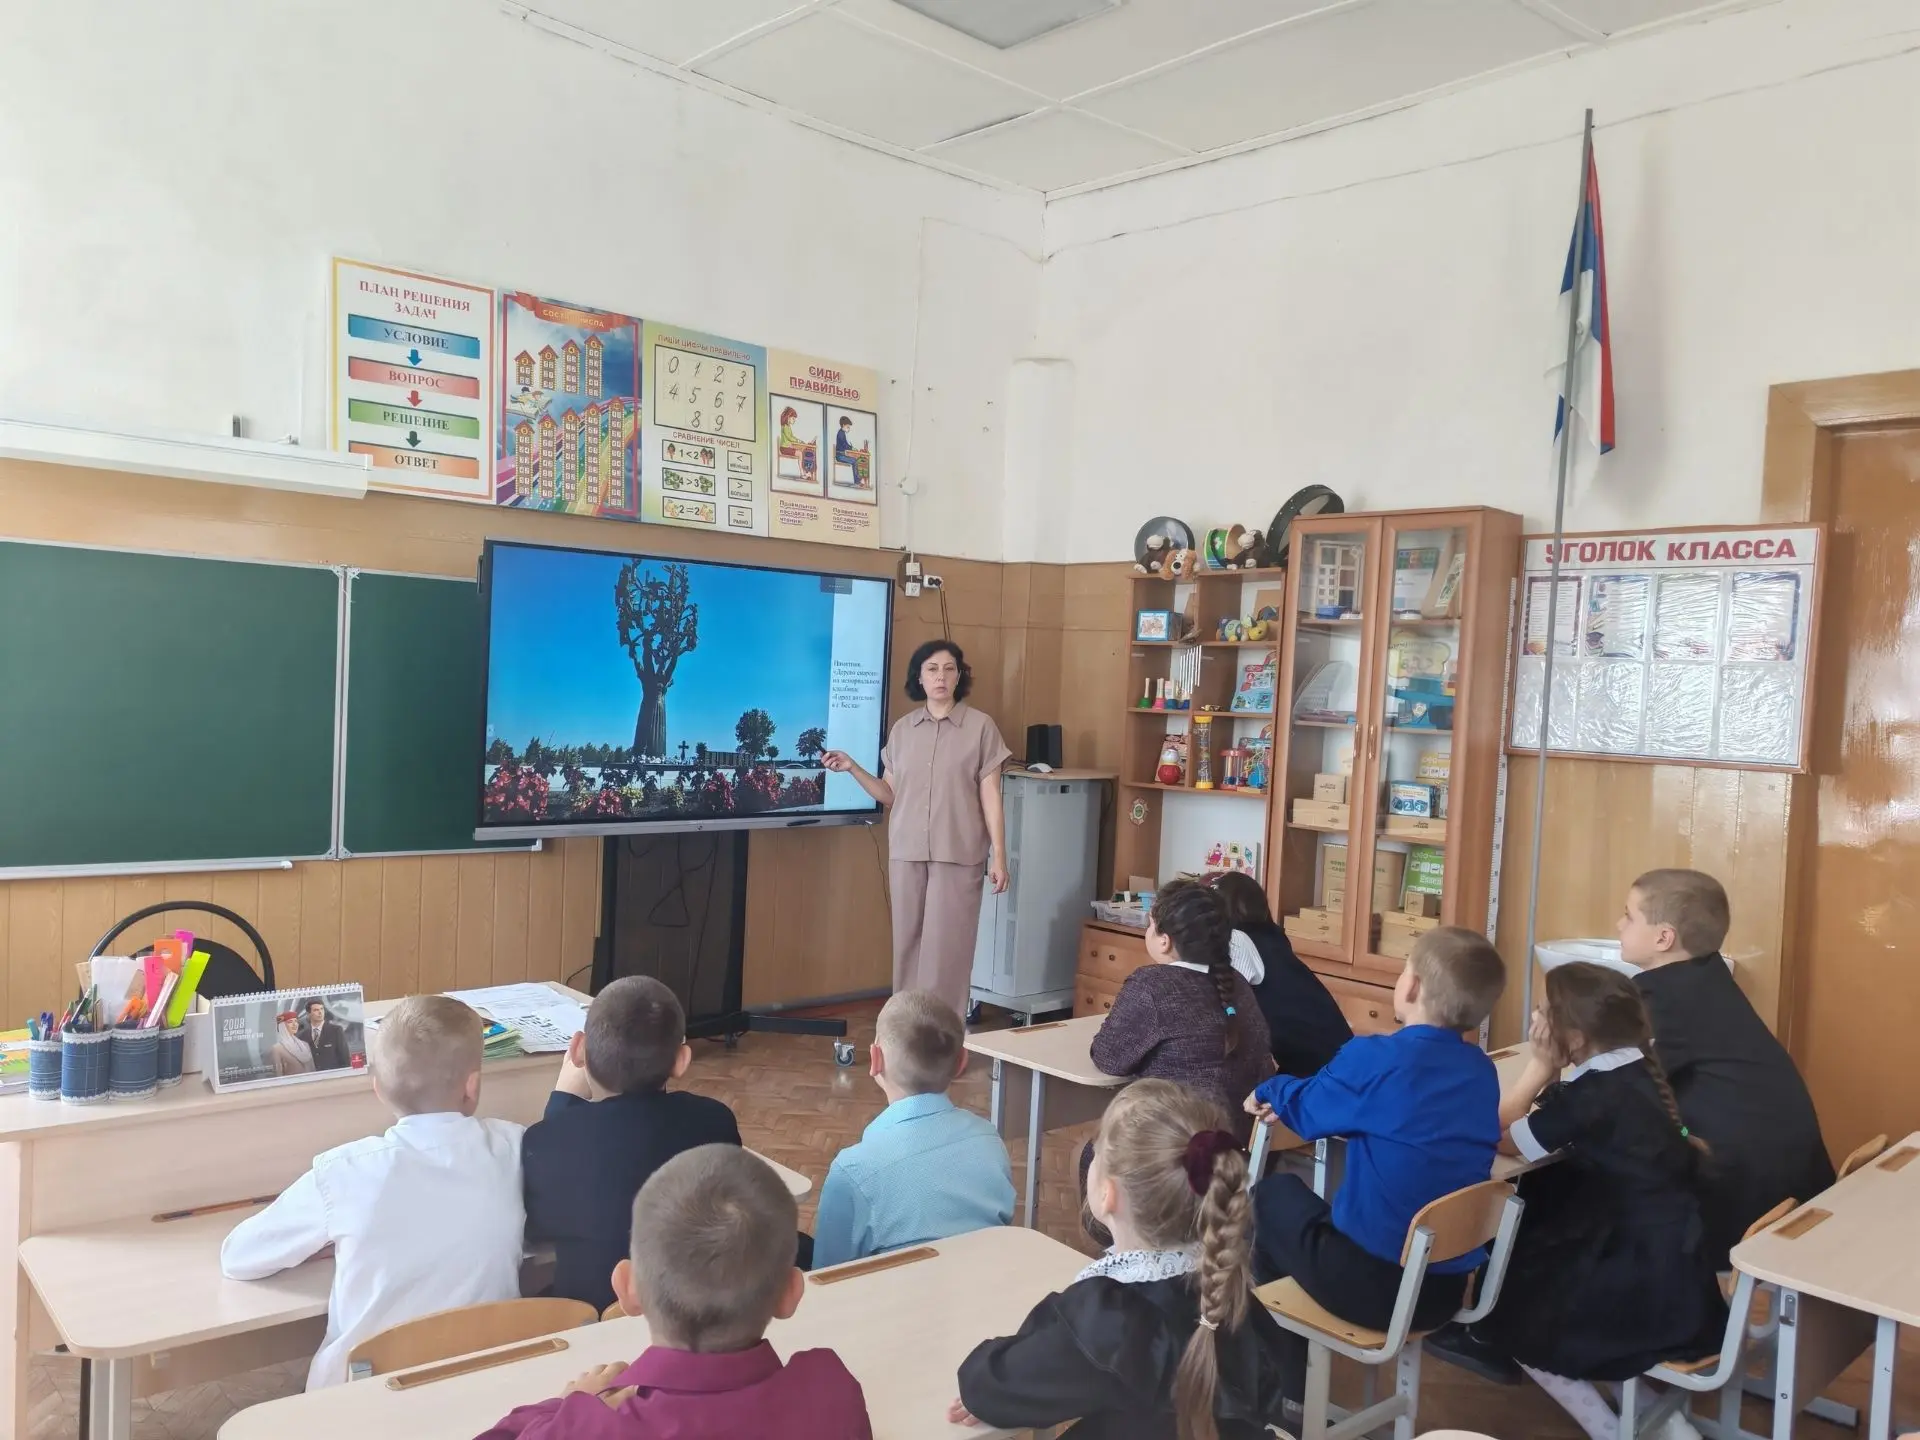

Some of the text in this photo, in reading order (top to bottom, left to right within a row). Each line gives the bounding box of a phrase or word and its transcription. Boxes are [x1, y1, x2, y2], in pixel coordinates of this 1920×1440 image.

[359, 280, 470, 312] ПЛАН РЕШЕНИЯ
[394, 302, 437, 320] ЗАДАЧ
[384, 327, 449, 349] УСЛОВИЕ
[388, 370, 445, 389] ВОПРОС
[668, 356, 747, 387] 0 1 2 3
[808, 365, 842, 382] СИДИ
[668, 383, 748, 413] 4 5 6 7
[789, 376, 860, 400] ПРАВИЛЬНО
[383, 410, 450, 431] РЕШЕНИЕ
[691, 410, 725, 432] 8 9
[672, 431, 740, 449] СРАВНЕНИЕ ЧИСЕЛ
[394, 453, 439, 470] ОТВЕТ
[1666, 538, 1797, 561] КЛАССА
[223, 1017, 245, 1031] 2008
